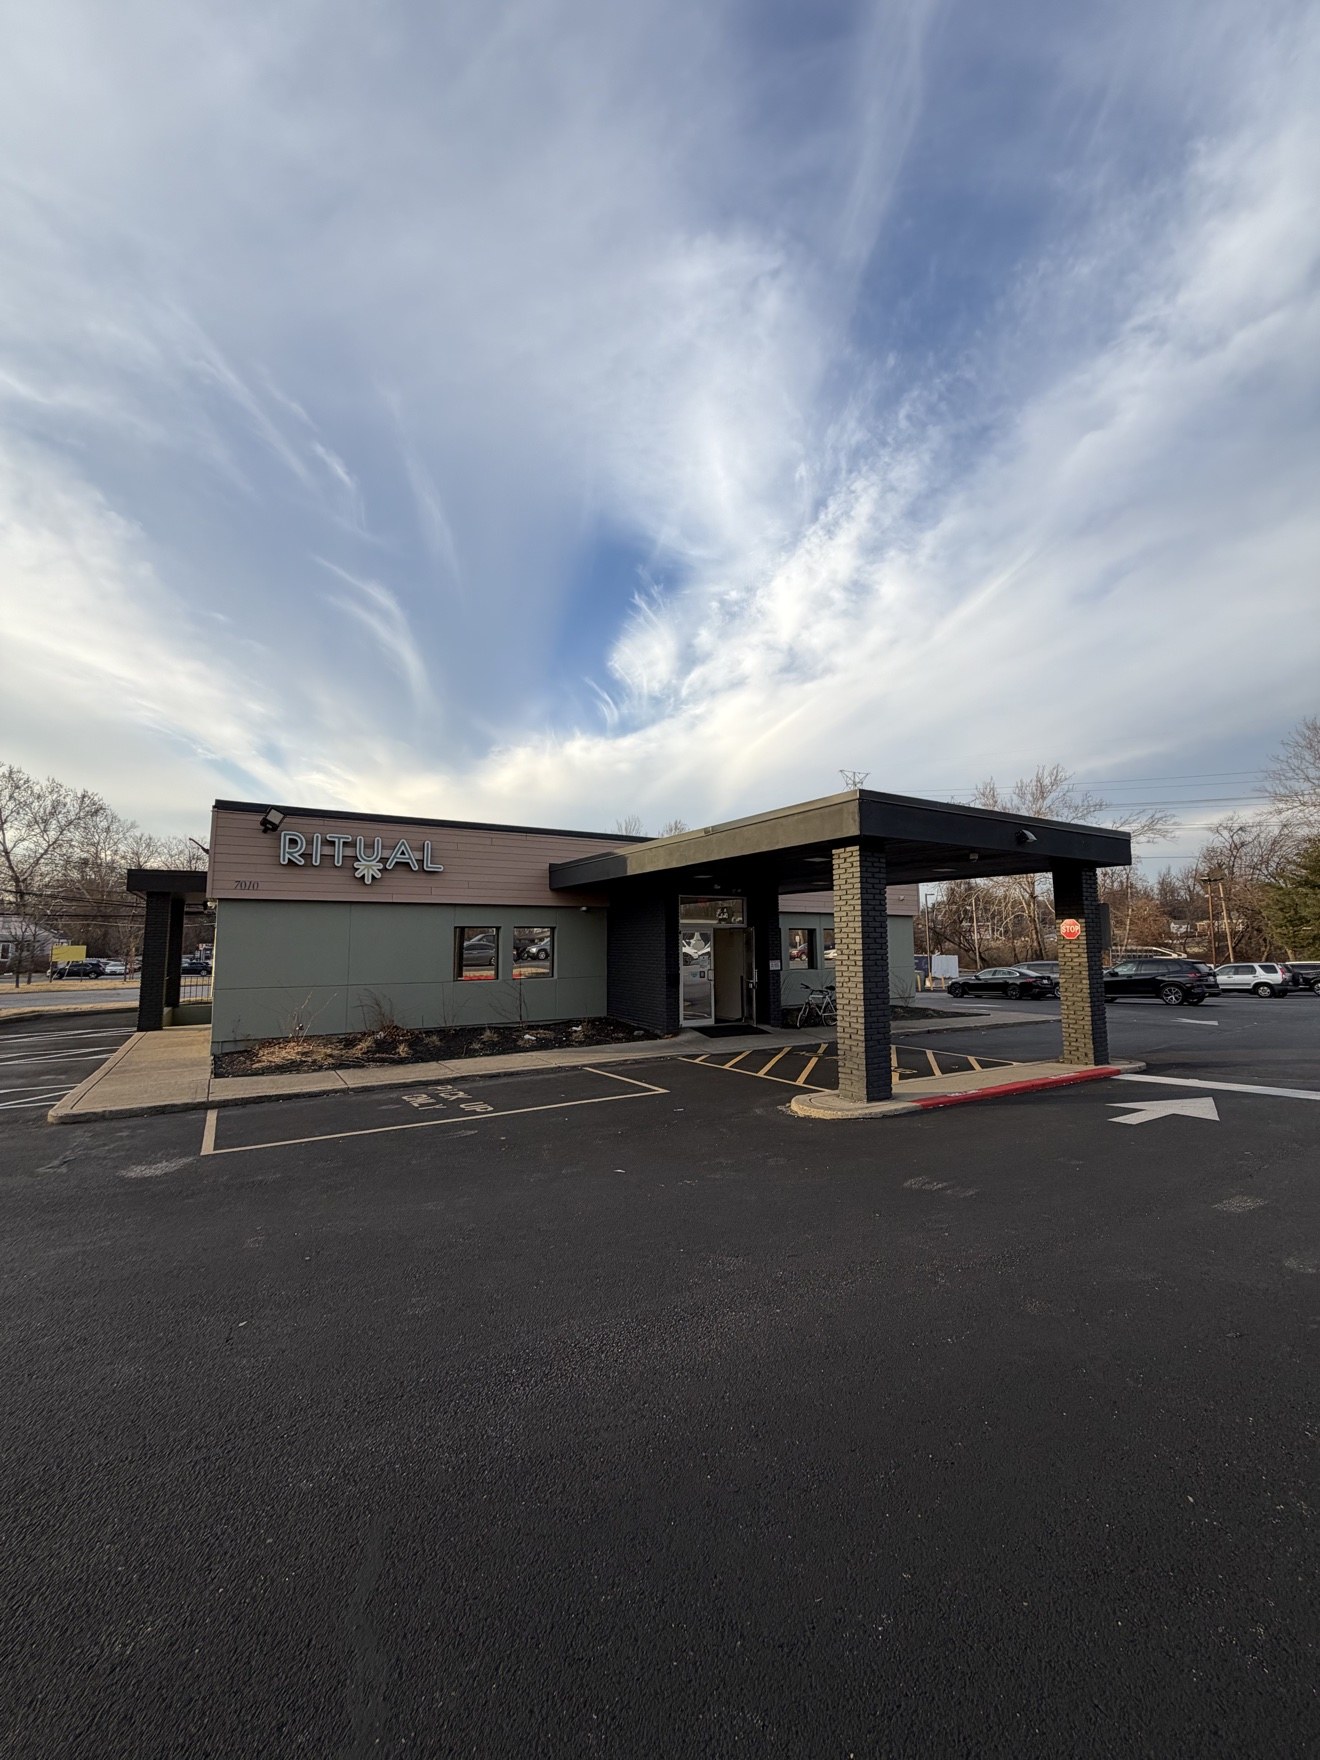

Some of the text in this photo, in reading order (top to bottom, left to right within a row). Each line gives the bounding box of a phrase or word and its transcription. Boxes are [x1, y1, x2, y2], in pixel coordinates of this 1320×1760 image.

[280, 831, 443, 871] RITUAL
[234, 880, 259, 890] 7010
[1062, 925, 1079, 933] STOP
[428, 1085, 494, 1112] PICK UP
